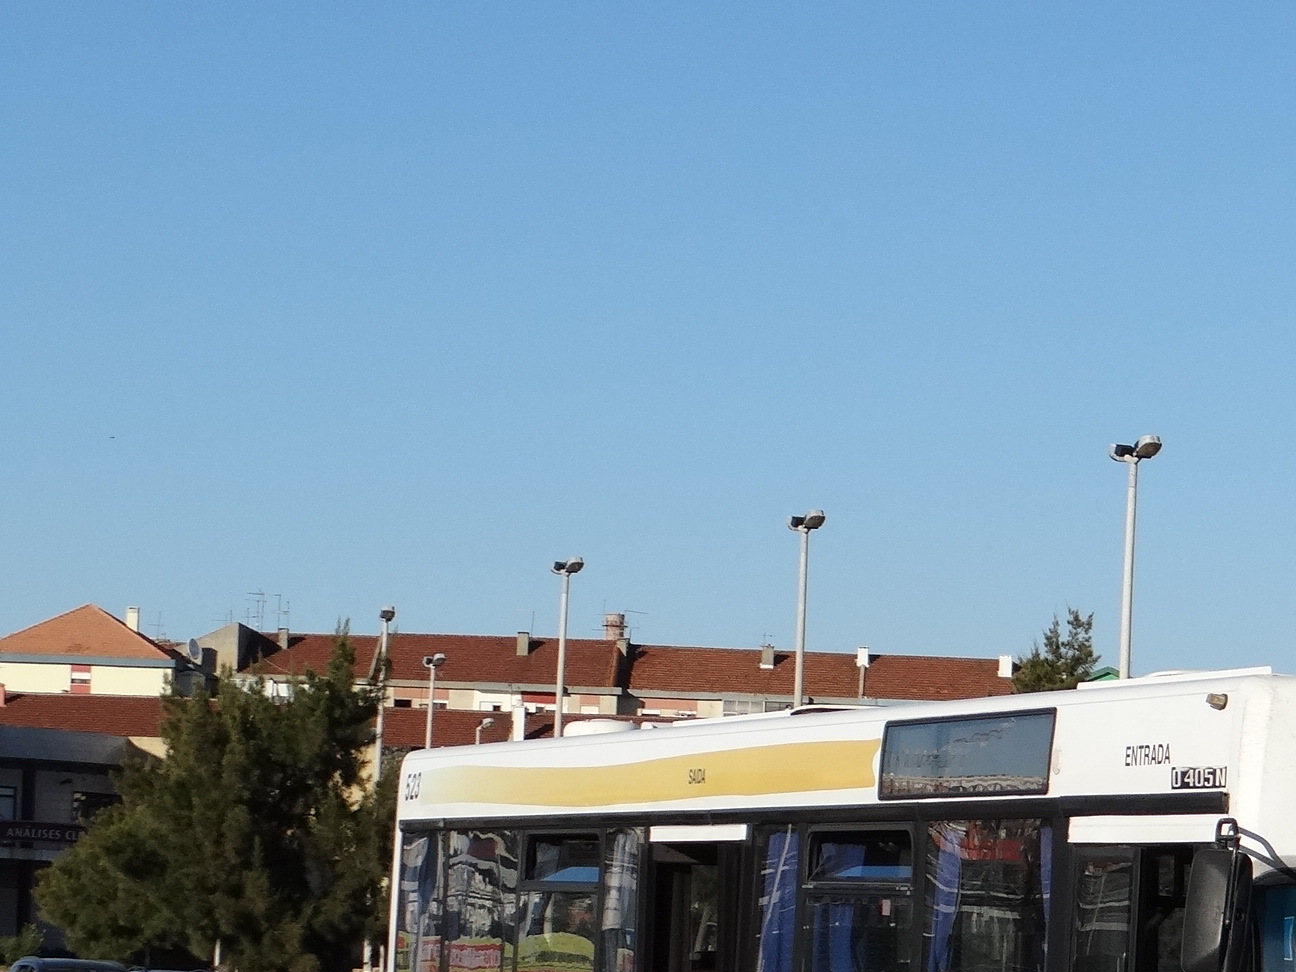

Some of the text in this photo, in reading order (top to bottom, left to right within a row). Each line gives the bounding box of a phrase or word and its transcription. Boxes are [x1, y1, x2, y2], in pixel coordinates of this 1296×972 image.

[1125, 743, 1170, 767] ENTRADA
[405, 771, 422, 801] 523
[6, 825, 61, 840] ANÁLISES
